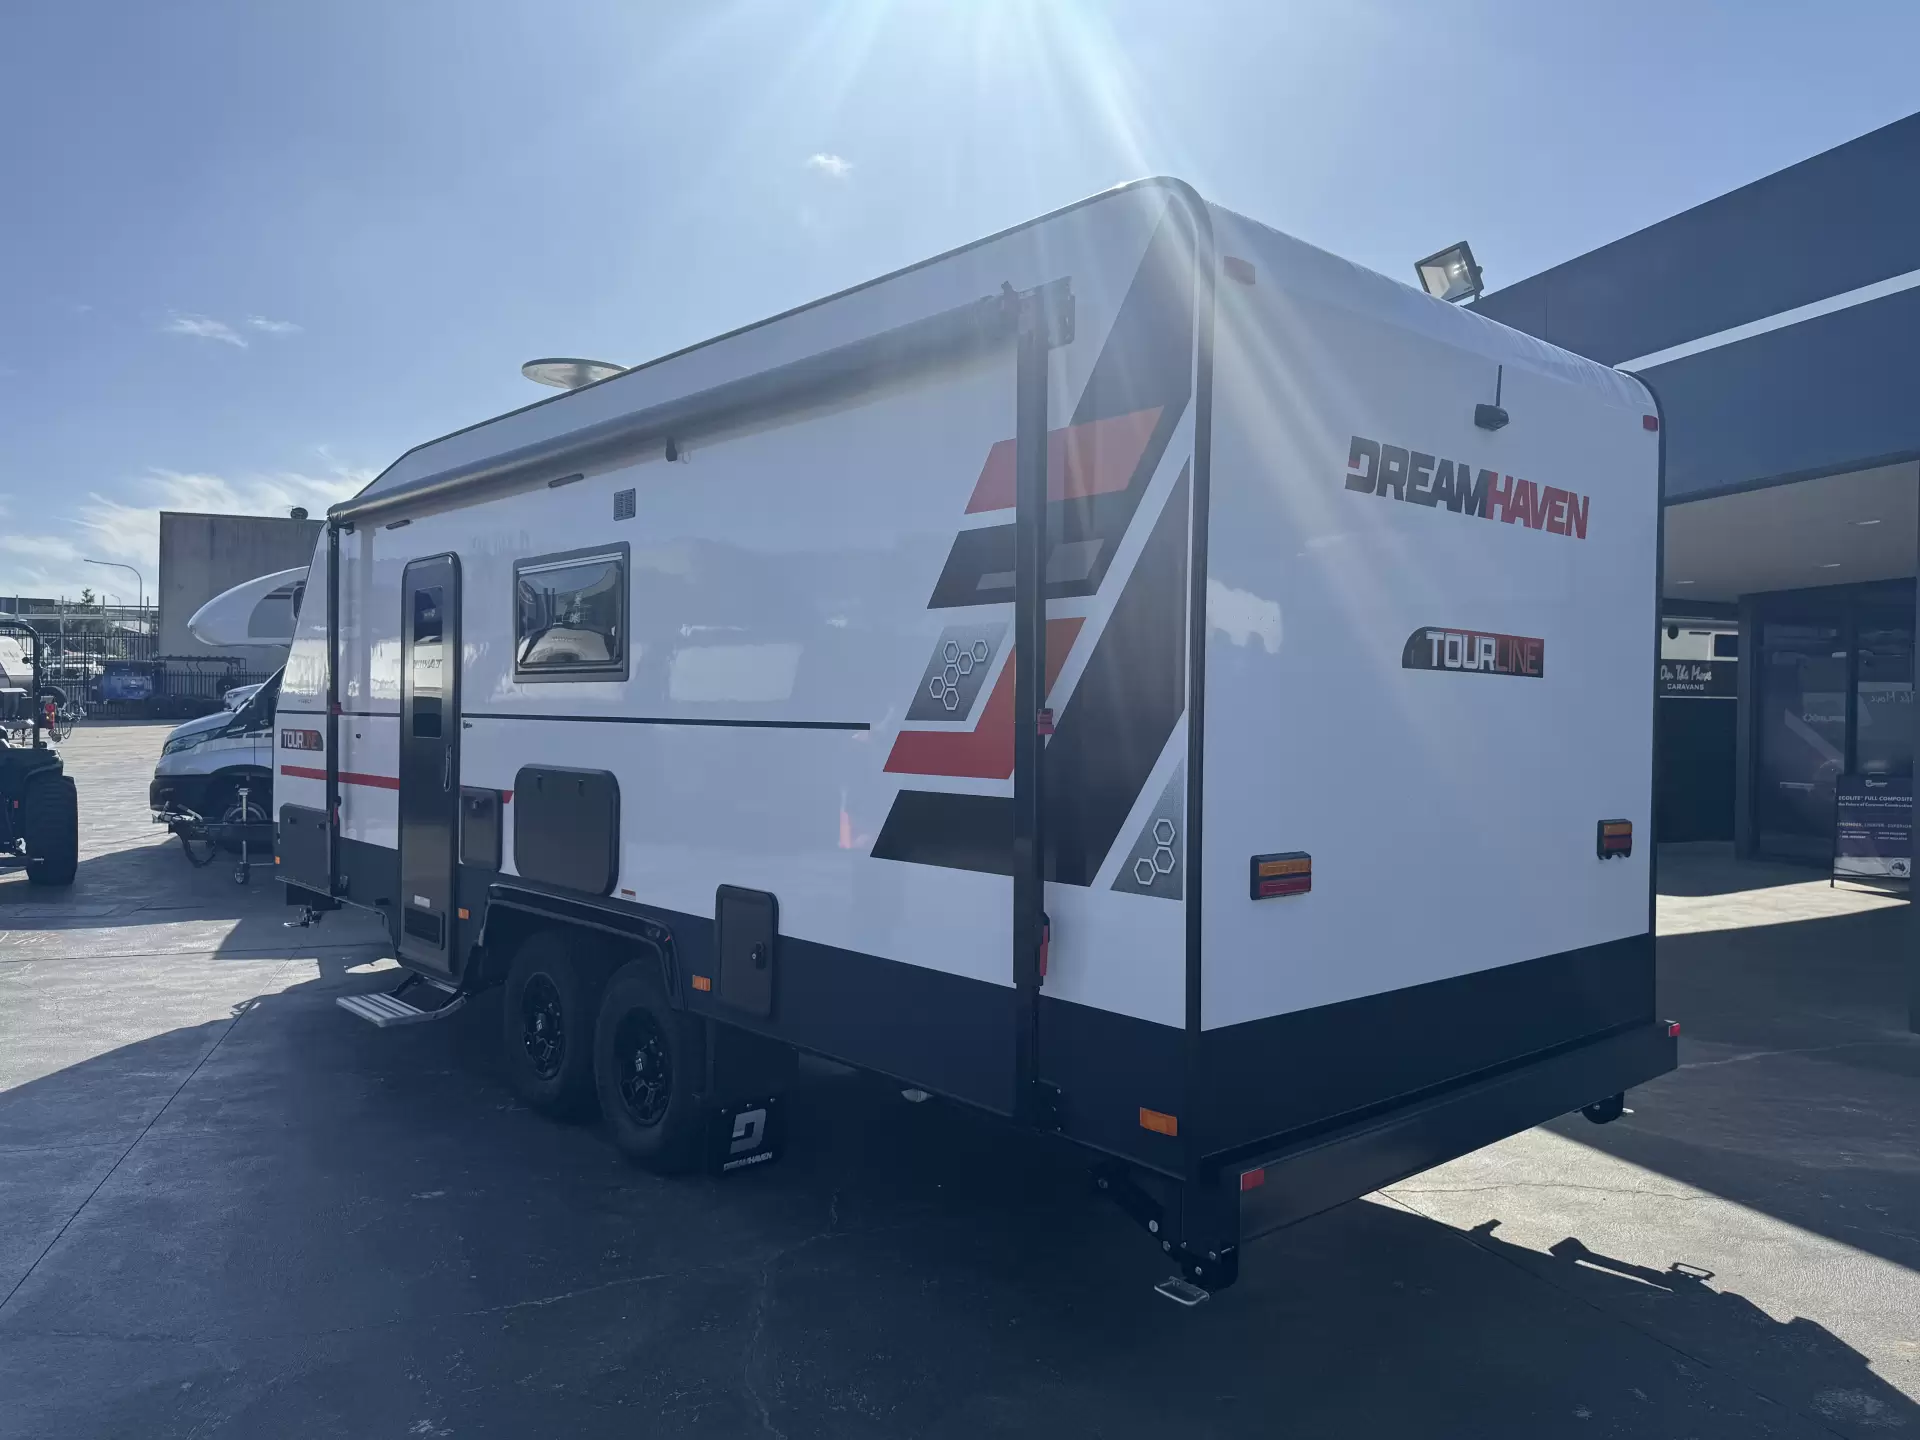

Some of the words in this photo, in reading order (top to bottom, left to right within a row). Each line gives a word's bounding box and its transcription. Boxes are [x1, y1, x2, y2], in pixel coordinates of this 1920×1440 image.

[1345, 435, 1590, 540] DREAMHAVEN
[1426, 631, 1540, 674] TOURLINE
[1676, 664, 1689, 681] The
[1691, 664, 1713, 682] Move
[1667, 683, 1705, 691] CARAVANS
[283, 730, 318, 749] TOURLINE
